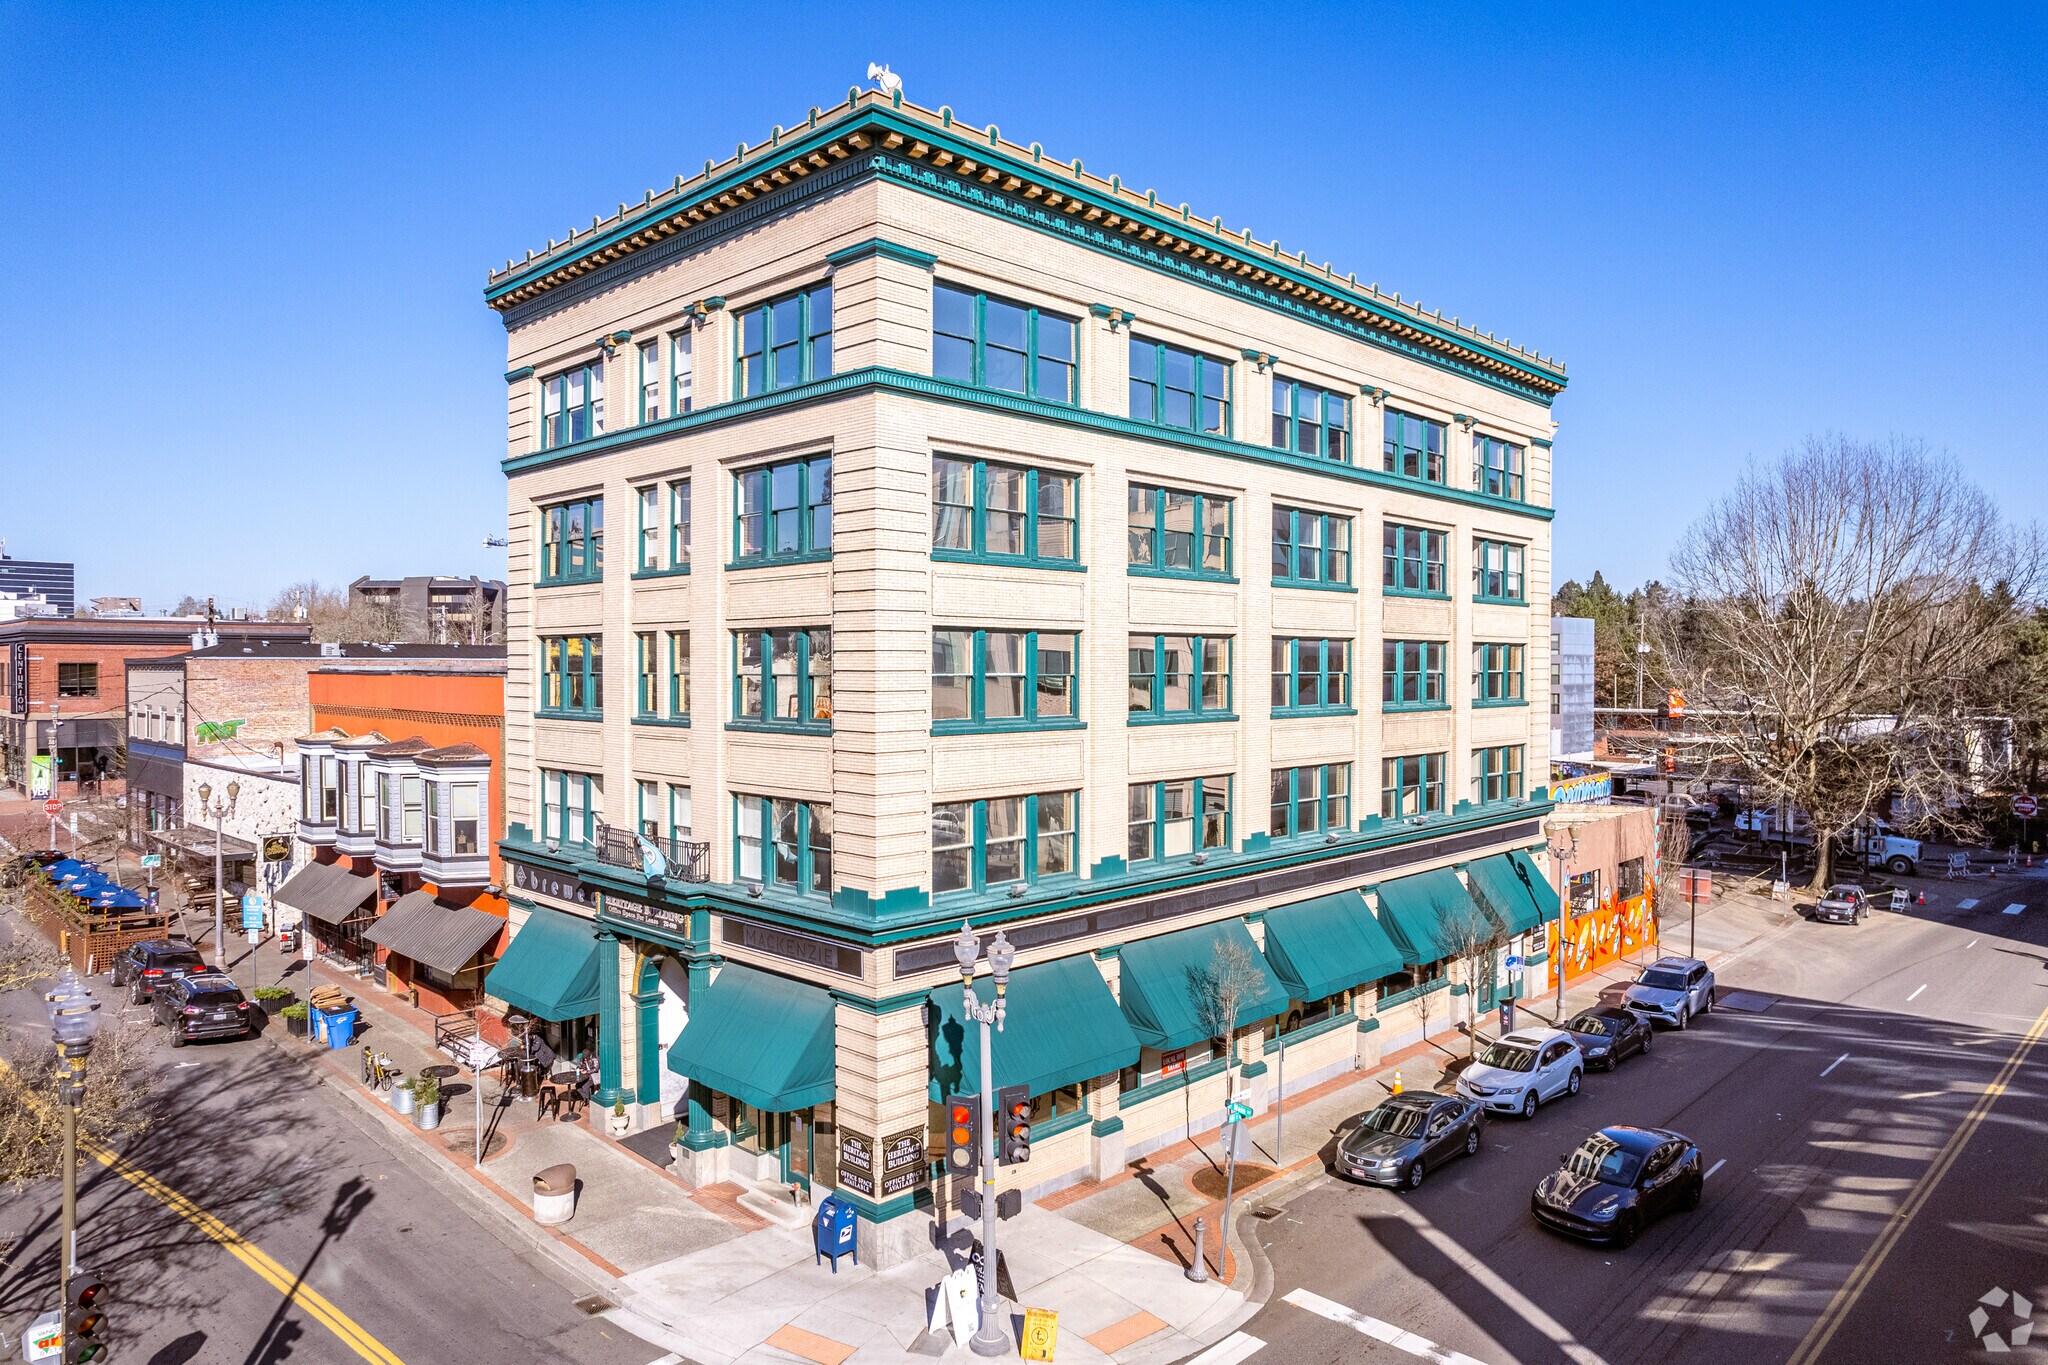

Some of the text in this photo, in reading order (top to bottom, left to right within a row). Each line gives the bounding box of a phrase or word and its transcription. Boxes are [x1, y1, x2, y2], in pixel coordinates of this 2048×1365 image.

[44, 803, 62, 811] STOP
[605, 895, 685, 924] HERITAGE BUILDING
[746, 928, 833, 964] MACKENZIE
[843, 1143, 870, 1160] HERITAGE
[851, 1139, 862, 1149] THE
[887, 1143, 920, 1160] HERITAGE
[897, 1138, 911, 1149] THE
[843, 1152, 869, 1169] BUILDING
[888, 1152, 919, 1169] BUILDING
[841, 1170, 872, 1188] OFFICE SPACE
[844, 1178, 869, 1193] AVAILABLE
[884, 1168, 923, 1188] OFFICE SPACE
[888, 1176, 919, 1193] AVAILABLE
[38, 1325, 62, 1336] VANCO
[38, 1335, 62, 1349] ar
